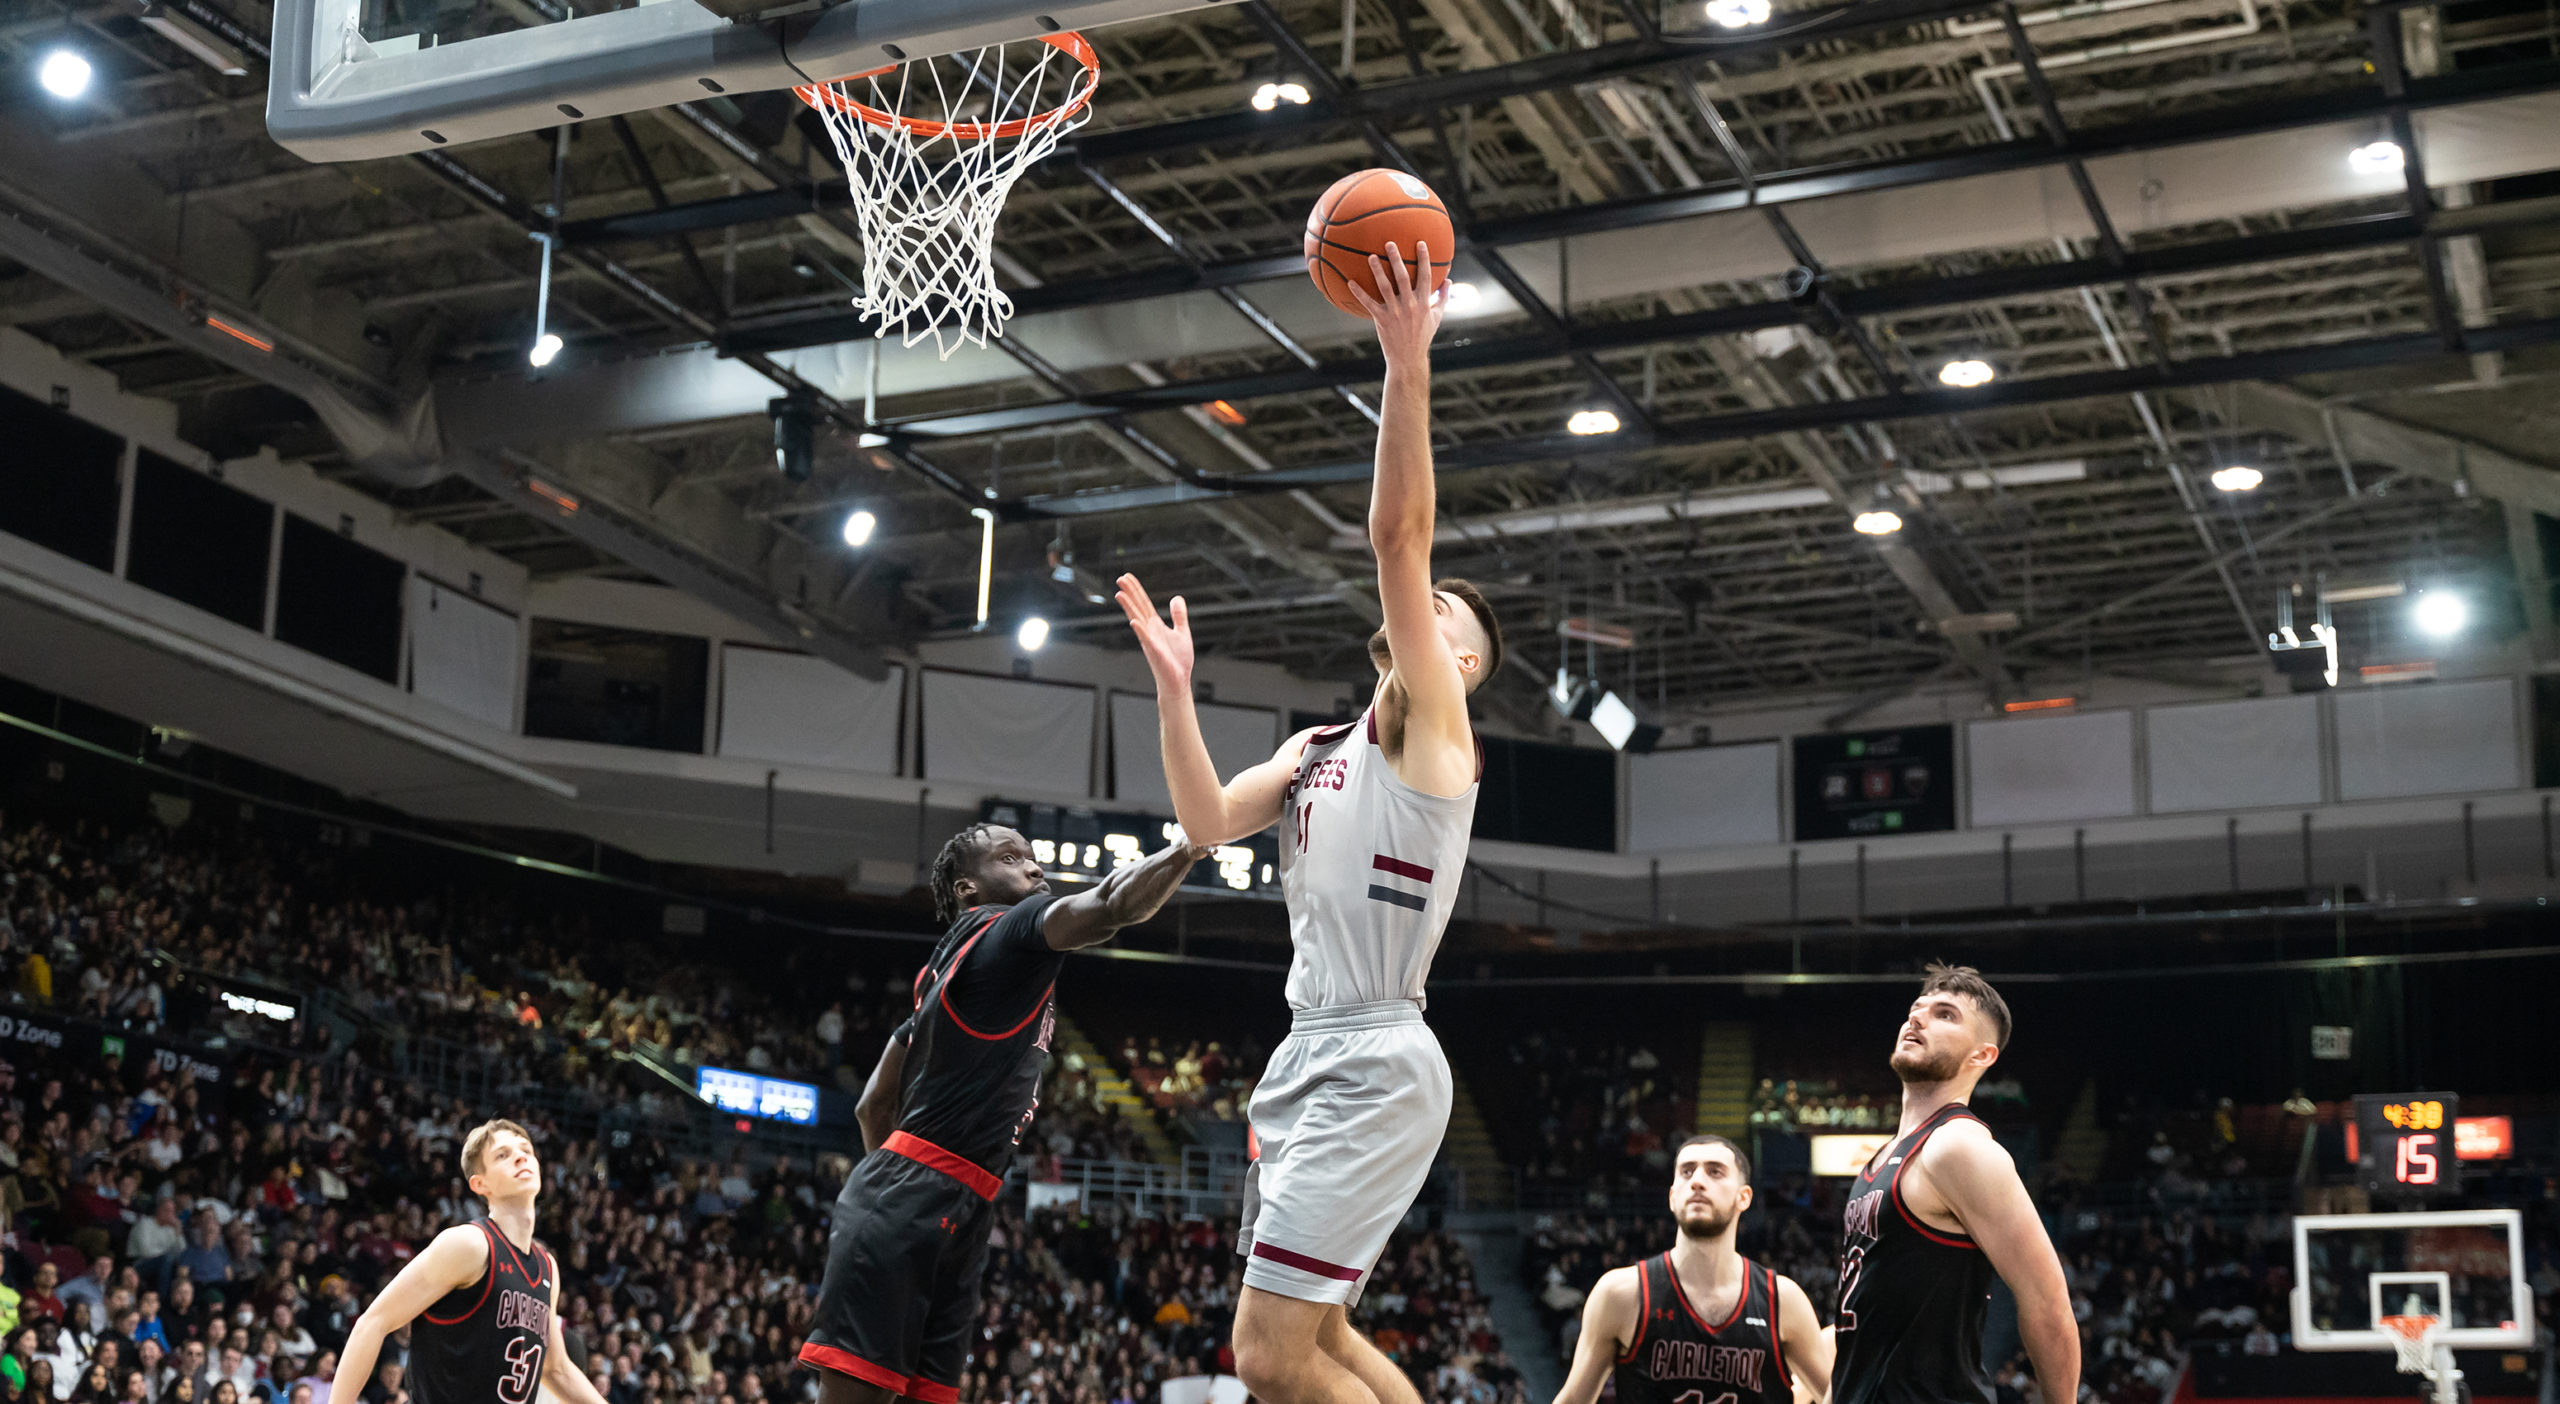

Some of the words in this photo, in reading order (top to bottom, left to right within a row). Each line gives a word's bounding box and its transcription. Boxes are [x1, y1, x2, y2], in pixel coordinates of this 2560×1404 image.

[0, 1016, 14, 1038] D
[16, 1020, 63, 1049] Zone
[2396, 1134, 2437, 1184] 15
[496, 1289, 551, 1347] CARLETO
[497, 1336, 542, 1404] 31
